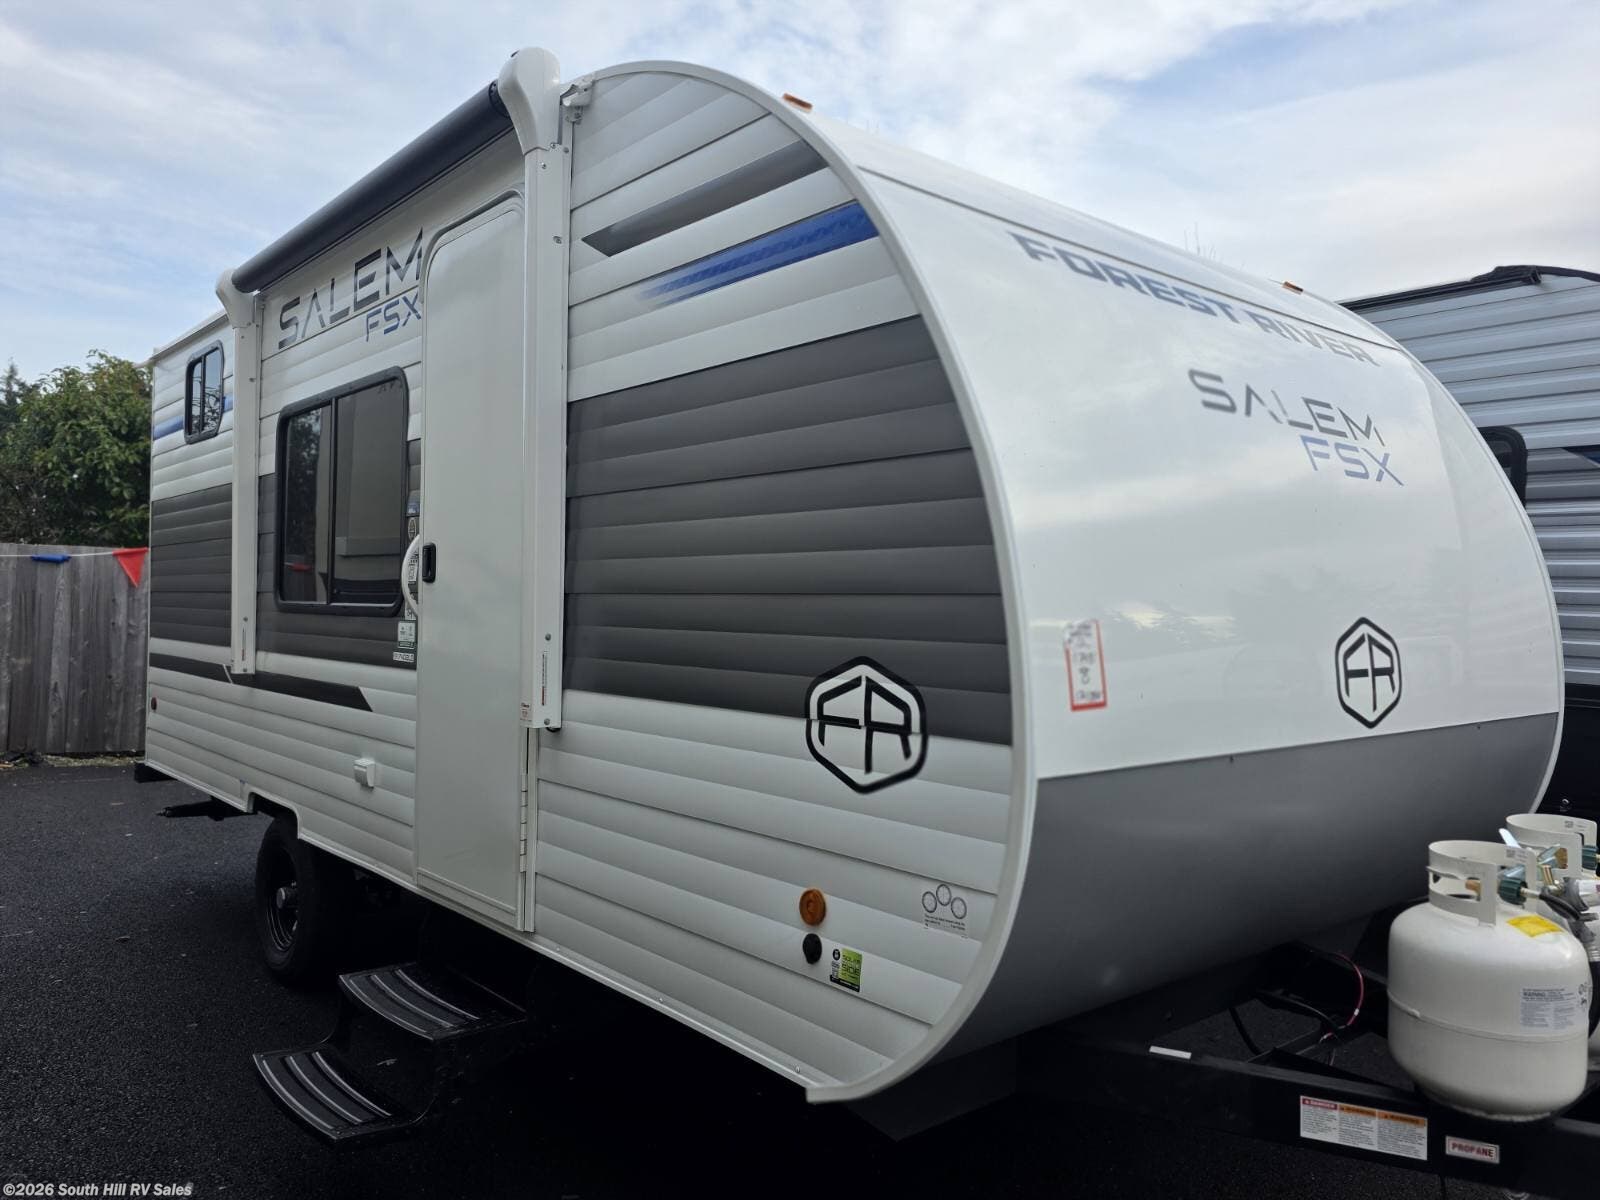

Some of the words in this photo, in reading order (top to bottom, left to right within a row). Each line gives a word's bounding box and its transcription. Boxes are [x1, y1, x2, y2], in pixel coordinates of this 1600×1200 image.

[279, 226, 423, 349] SALEM
[366, 292, 422, 342] FSX
[1004, 230, 1241, 324] FOREST
[1240, 309, 1381, 366] RIVER
[1188, 369, 1386, 447] SALEM
[1299, 434, 1404, 487] FSX
[1451, 1141, 1495, 1158] PROPANE
